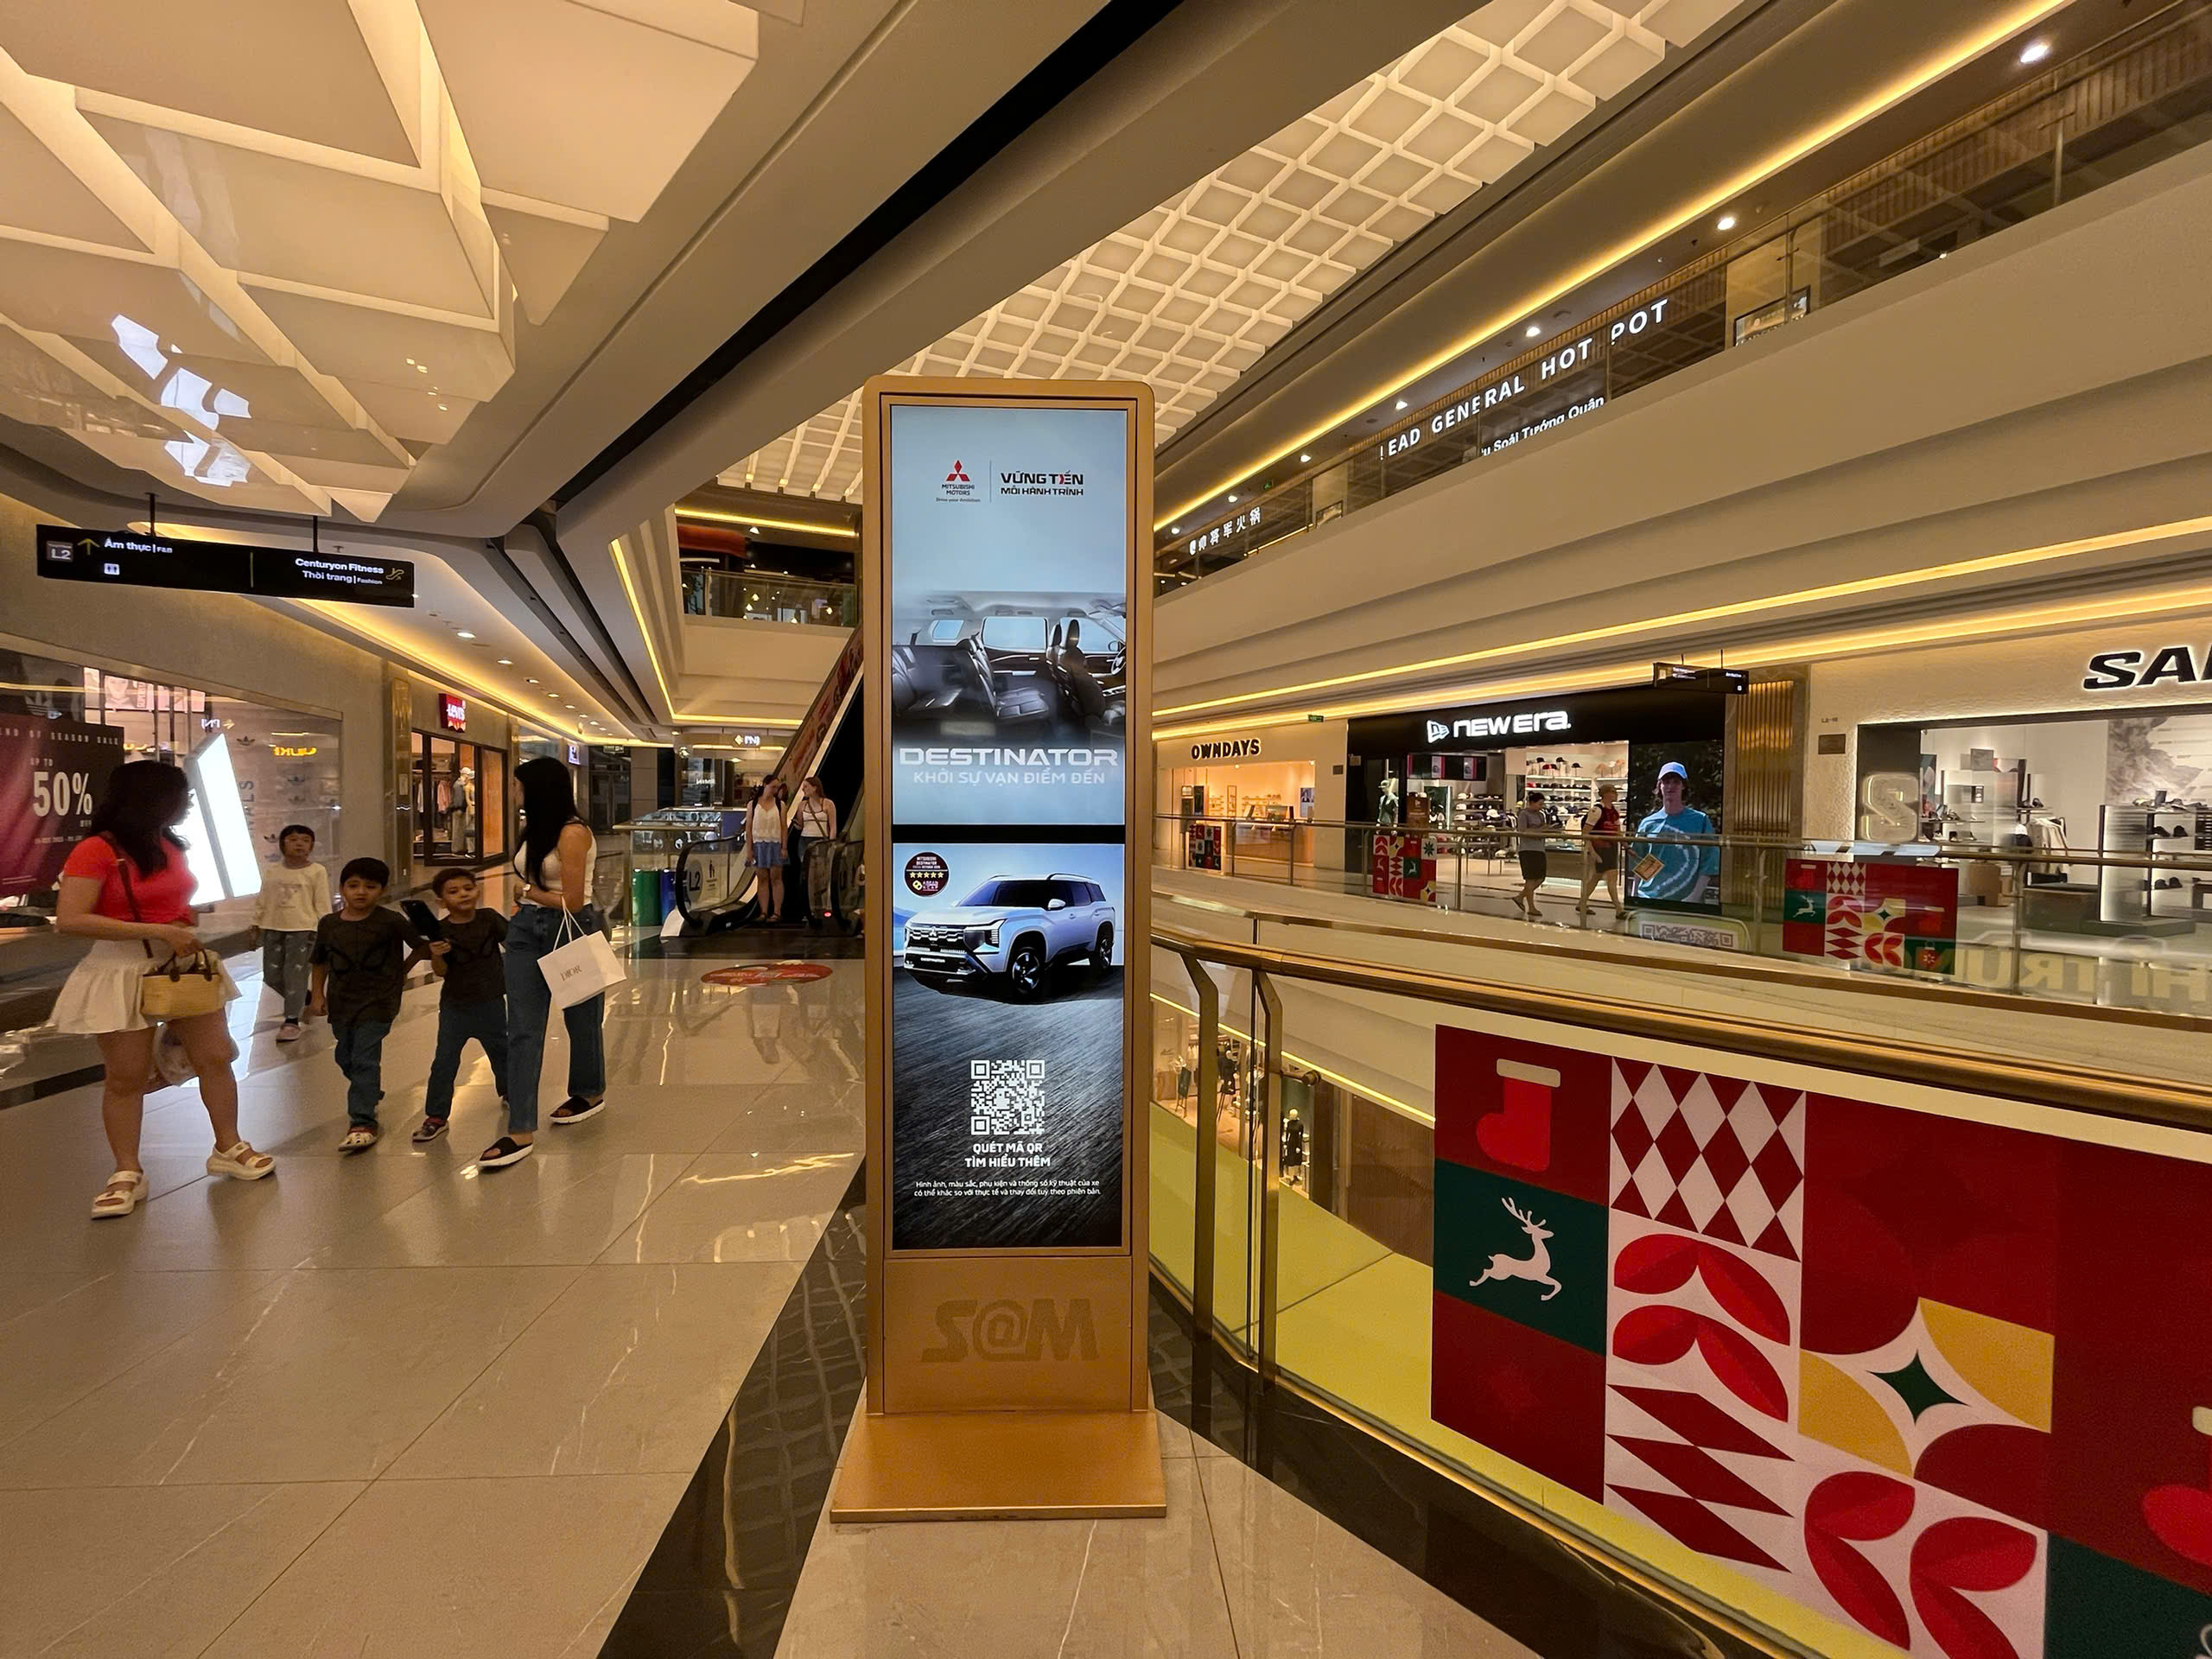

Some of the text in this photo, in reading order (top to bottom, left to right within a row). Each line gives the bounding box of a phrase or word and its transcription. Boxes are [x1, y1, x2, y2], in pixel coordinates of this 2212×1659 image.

[1431, 375, 1526, 434] GENERAL
[1541, 338, 1592, 380] HOT
[1611, 299, 1668, 345] POT
[51, 548, 71, 561] L2
[295, 557, 384, 575] Centuryon Fitness
[327, 573, 353, 584] trang
[2082, 646, 2212, 690] SA
[899, 747, 1118, 766] DESTINATOR
[1192, 738, 1262, 760] OWNDAYS
[33, 771, 92, 817] 50%
[560, 965, 582, 982] DIOR
[973, 1141, 1043, 1154] QUÉT MÃ QR
[964, 1153, 1051, 1167] TÌM HIỂU THÊM
